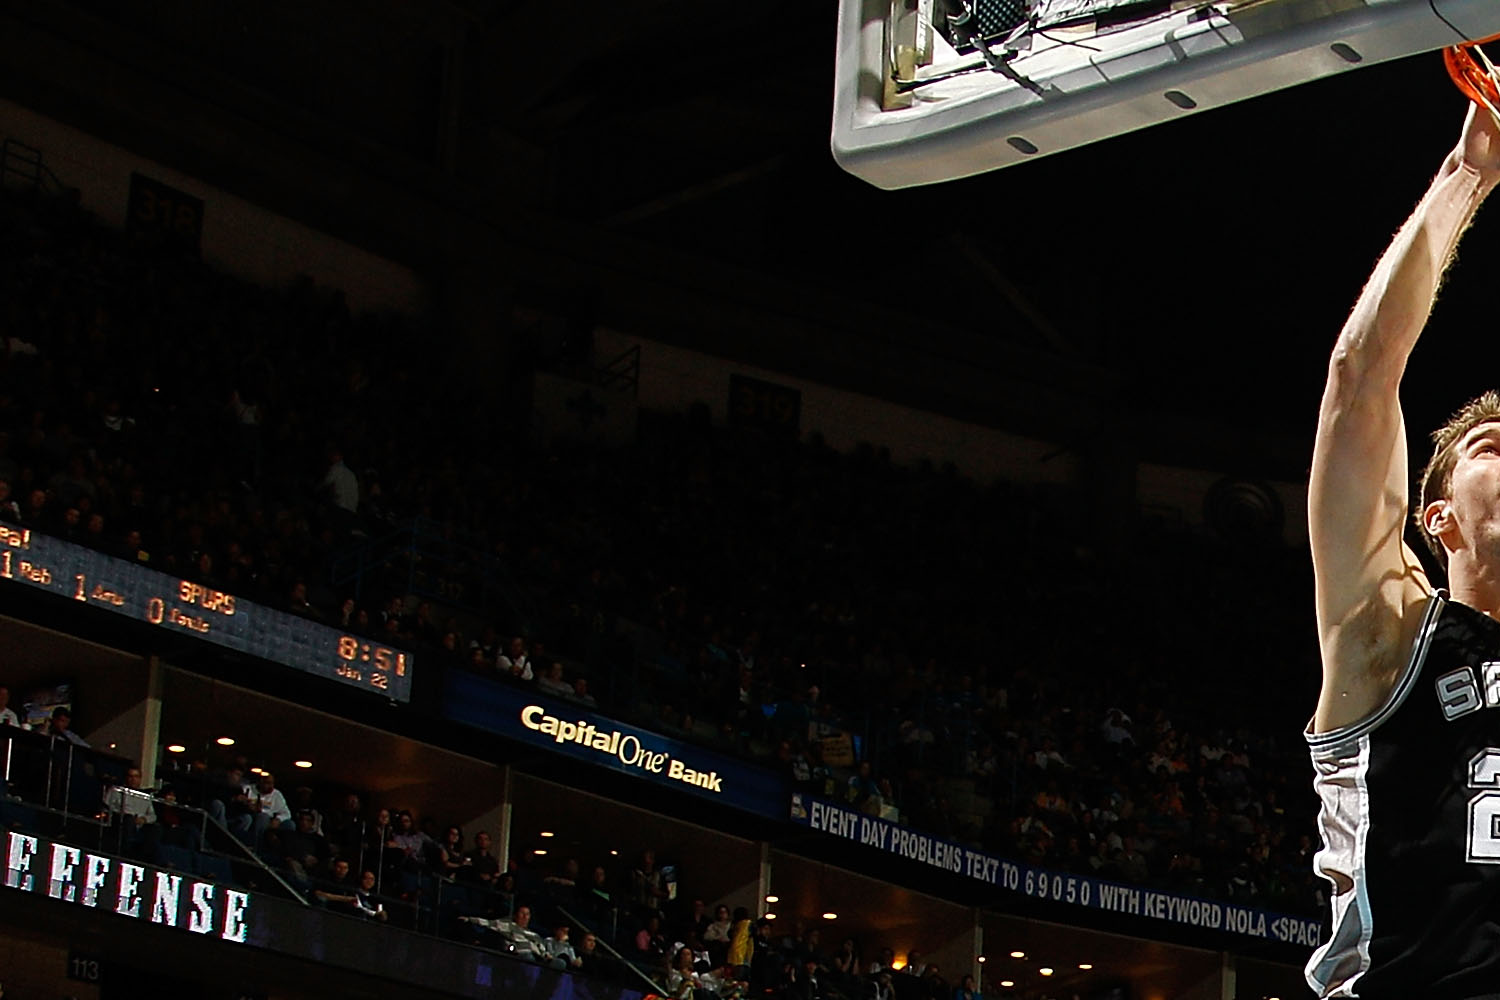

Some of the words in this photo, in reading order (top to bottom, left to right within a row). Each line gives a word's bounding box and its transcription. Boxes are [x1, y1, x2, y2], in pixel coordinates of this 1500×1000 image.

[179, 580, 236, 615] SPURS
[669, 759, 723, 793] Bank
[810, 801, 858, 840] EVENT
[861, 818, 889, 850] DAY
[890, 826, 962, 873] PROBLEMS
[965, 850, 999, 884] TEXT
[1002, 862, 1019, 890] TO
[1099, 883, 1140, 915] WITH
[1144, 891, 1222, 929] KEYWORD
[1226, 907, 1267, 938] NOLA
[72, 957, 99, 981] 113
